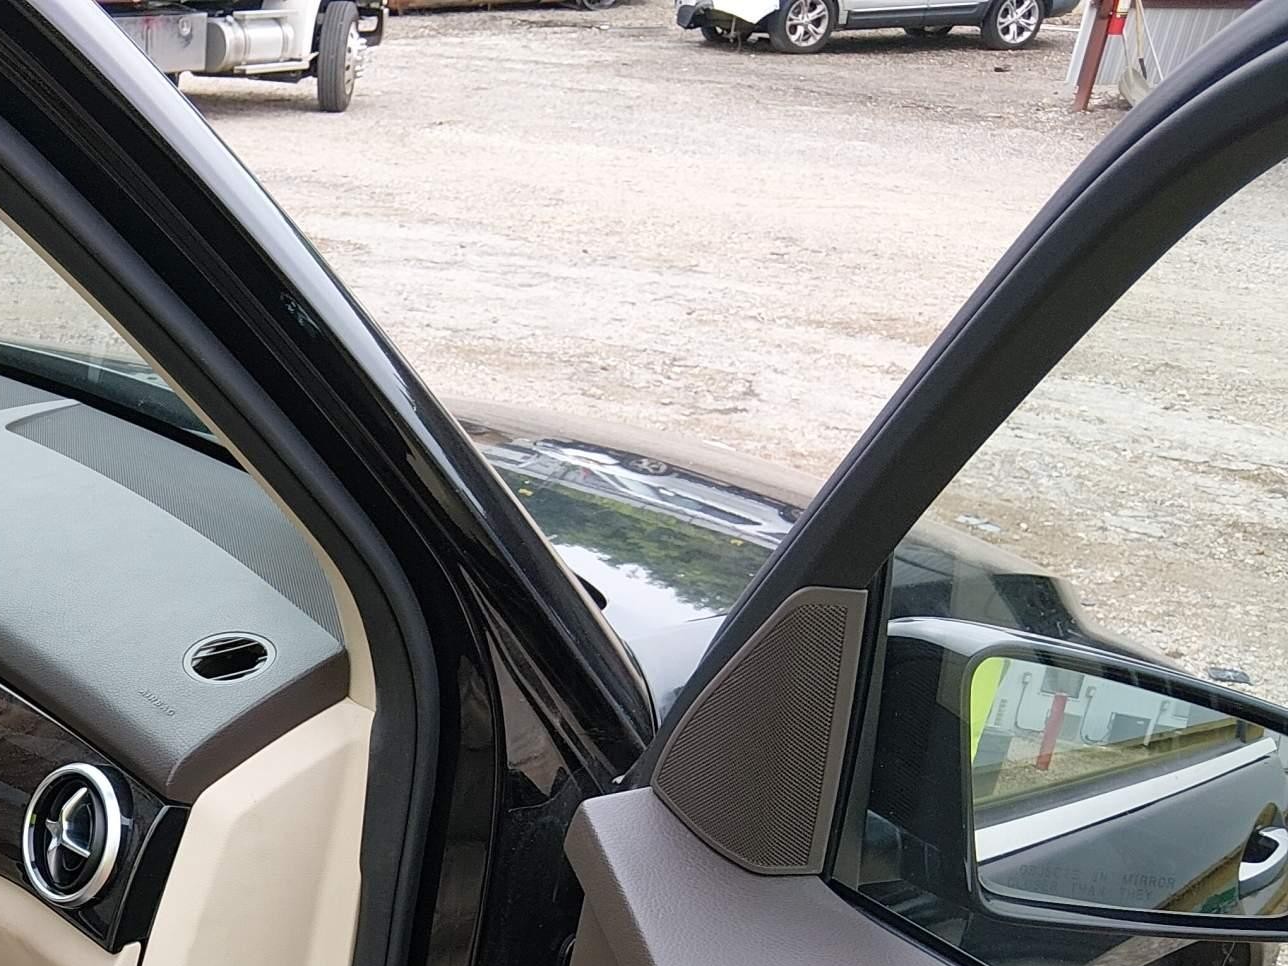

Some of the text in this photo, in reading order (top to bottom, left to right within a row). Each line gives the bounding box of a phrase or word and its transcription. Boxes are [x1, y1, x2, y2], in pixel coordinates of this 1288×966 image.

[136, 687, 176, 717] AIRBAG
[1122, 872, 1176, 888] MIRROR
[1120, 887, 1153, 901] THEY
